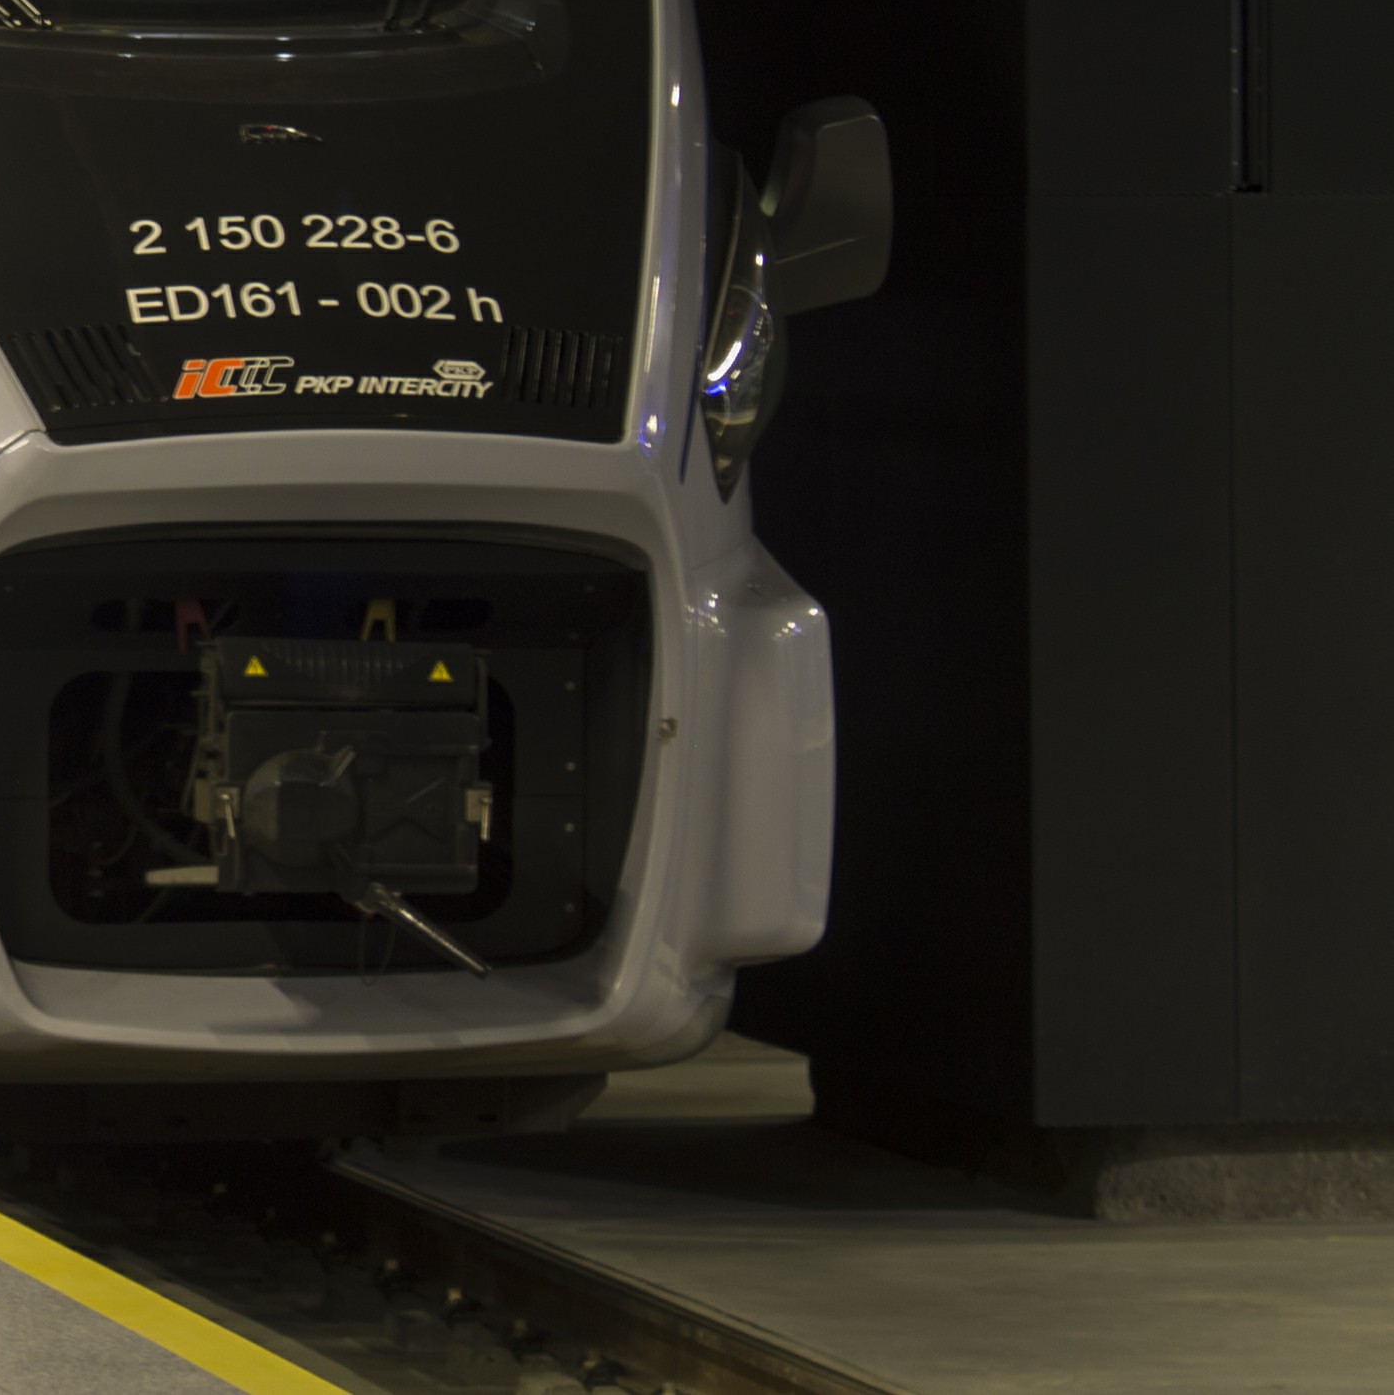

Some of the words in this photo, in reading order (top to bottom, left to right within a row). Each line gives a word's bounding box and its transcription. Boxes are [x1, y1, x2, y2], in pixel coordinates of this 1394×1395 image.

[129, 219, 167, 255] 2
[185, 214, 286, 252] 150
[302, 213, 461, 254] 228-6
[126, 281, 302, 324] ED161
[356, 282, 455, 321] 002
[468, 287, 504, 324] h
[294, 375, 354, 395] PKP
[357, 375, 493, 399] INTERCITY
